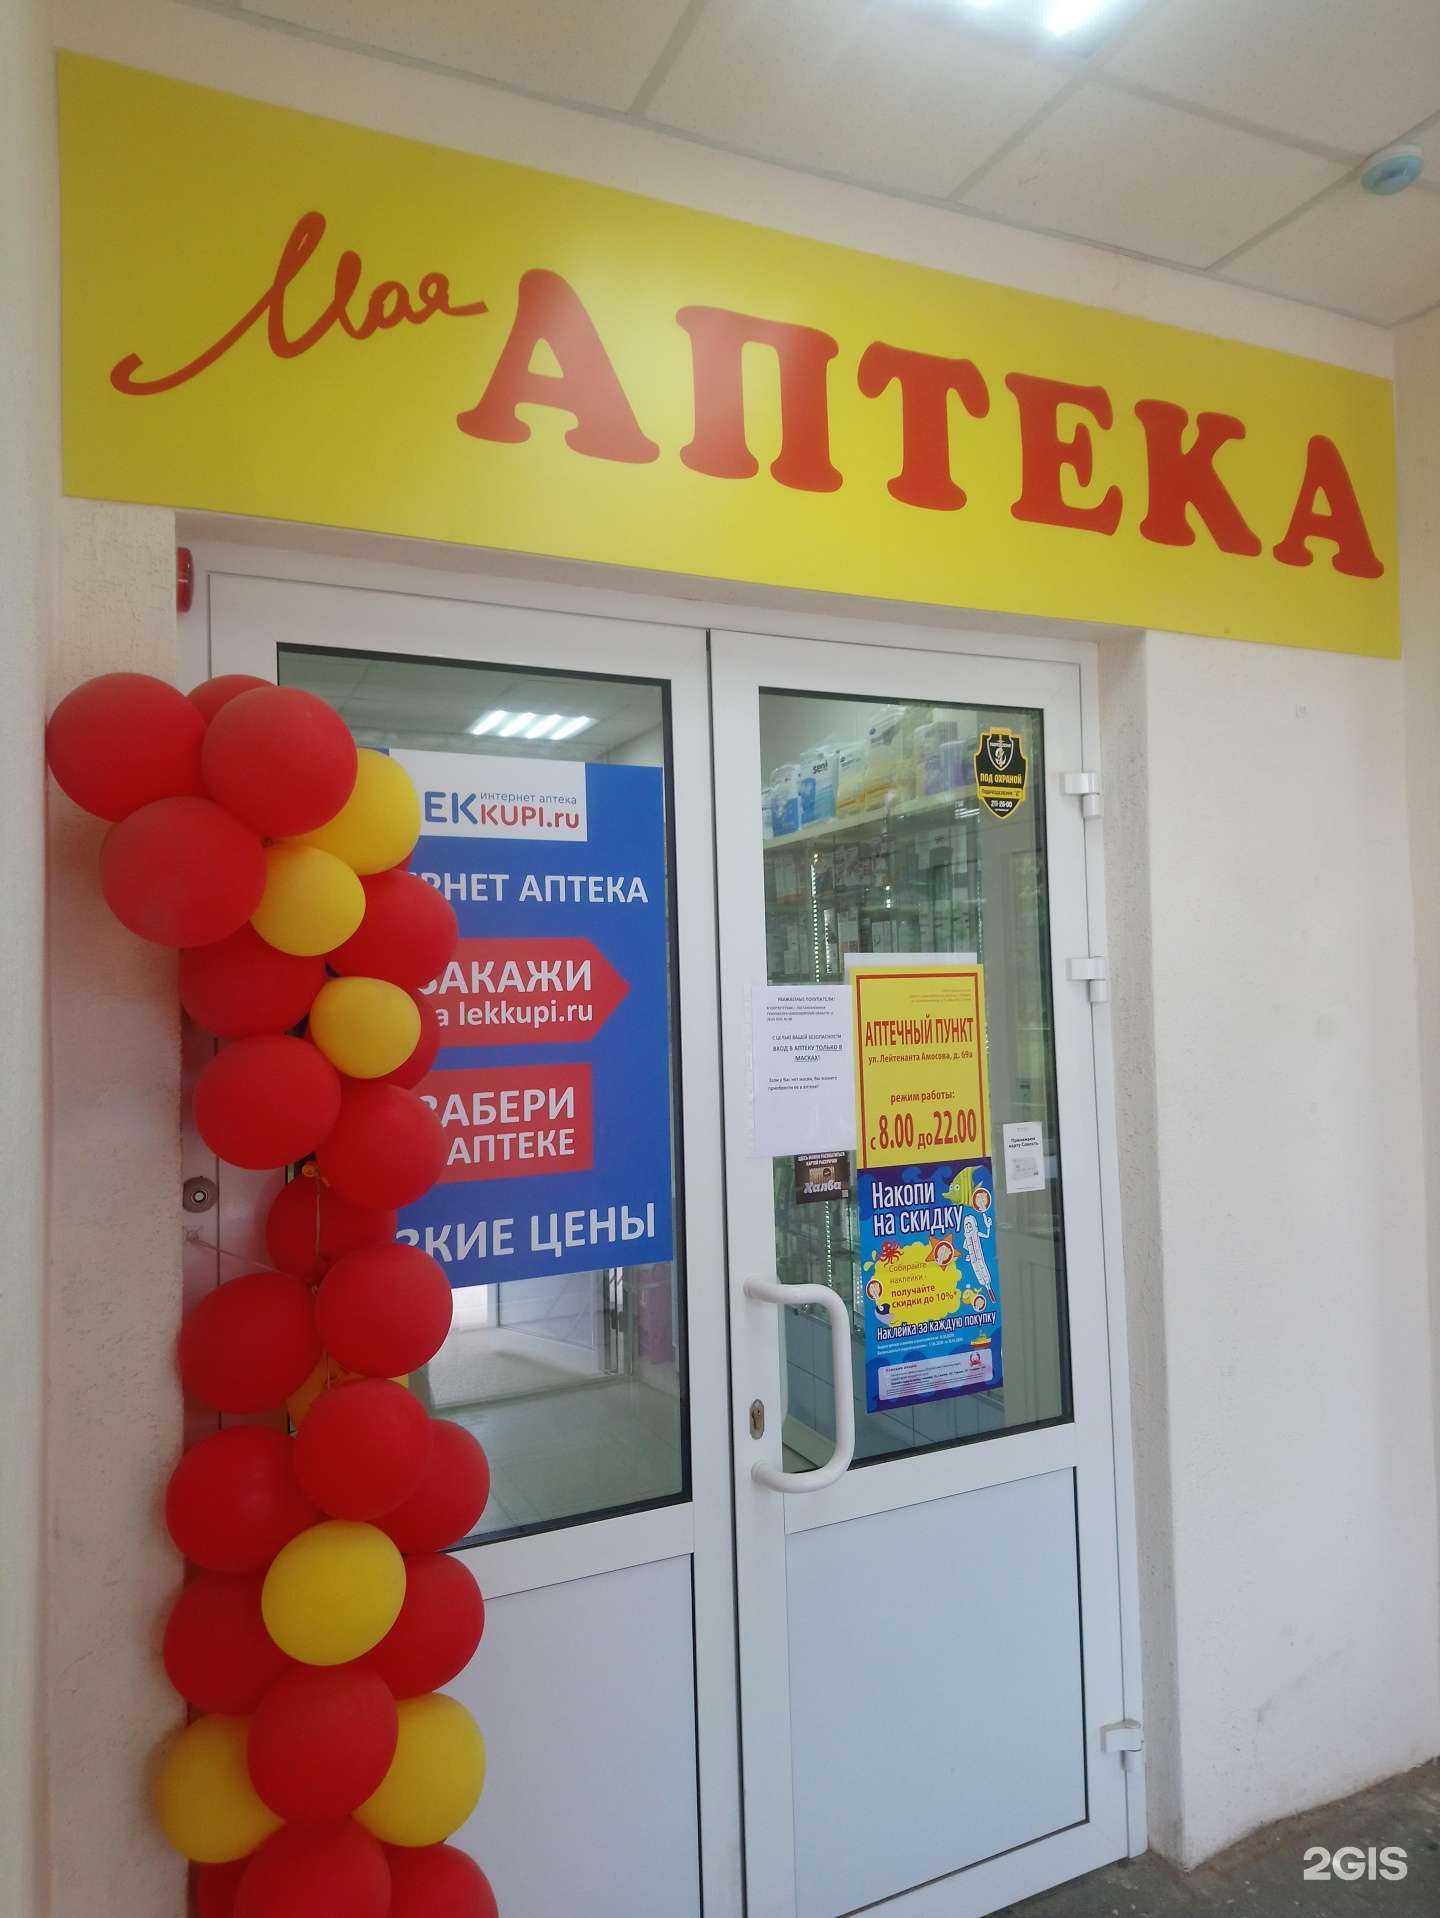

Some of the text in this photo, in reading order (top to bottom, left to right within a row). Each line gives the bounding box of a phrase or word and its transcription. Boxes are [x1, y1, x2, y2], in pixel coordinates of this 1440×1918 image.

[456, 268, 1385, 579] АПТЕКА
[980, 772, 1022, 784] ПОД ОХРАНОЙ
[480, 791, 577, 805] интернет аптека
[518, 873, 649, 903] АПТЕКА
[458, 999, 593, 1029] lekkupi.ru
[865, 1013, 974, 1047] АПТЕЧНЫЙ ПУНКТ
[868, 1055, 879, 1065] ул.
[880, 1053, 920, 1064] Лейтенанта
[953, 1052, 960, 1060] д.
[961, 1050, 973, 1059] 69а
[890, 1090, 956, 1105] режим работы:
[870, 1108, 977, 1150] с 8.00 до 22.00
[446, 1128, 575, 1166] АПТЕКЕ
[803, 1179, 842, 1194] Халва
[872, 1181, 935, 1209] Накопи
[530, 1202, 655, 1258] ЦЕНЫ
[873, 1205, 964, 1237] на скидку
[891, 1284, 936, 1298] получайте
[892, 1297, 922, 1309] скидки
[923, 1296, 935, 1305] до
[877, 1311, 997, 1341] Наклейка за каждую покупку
